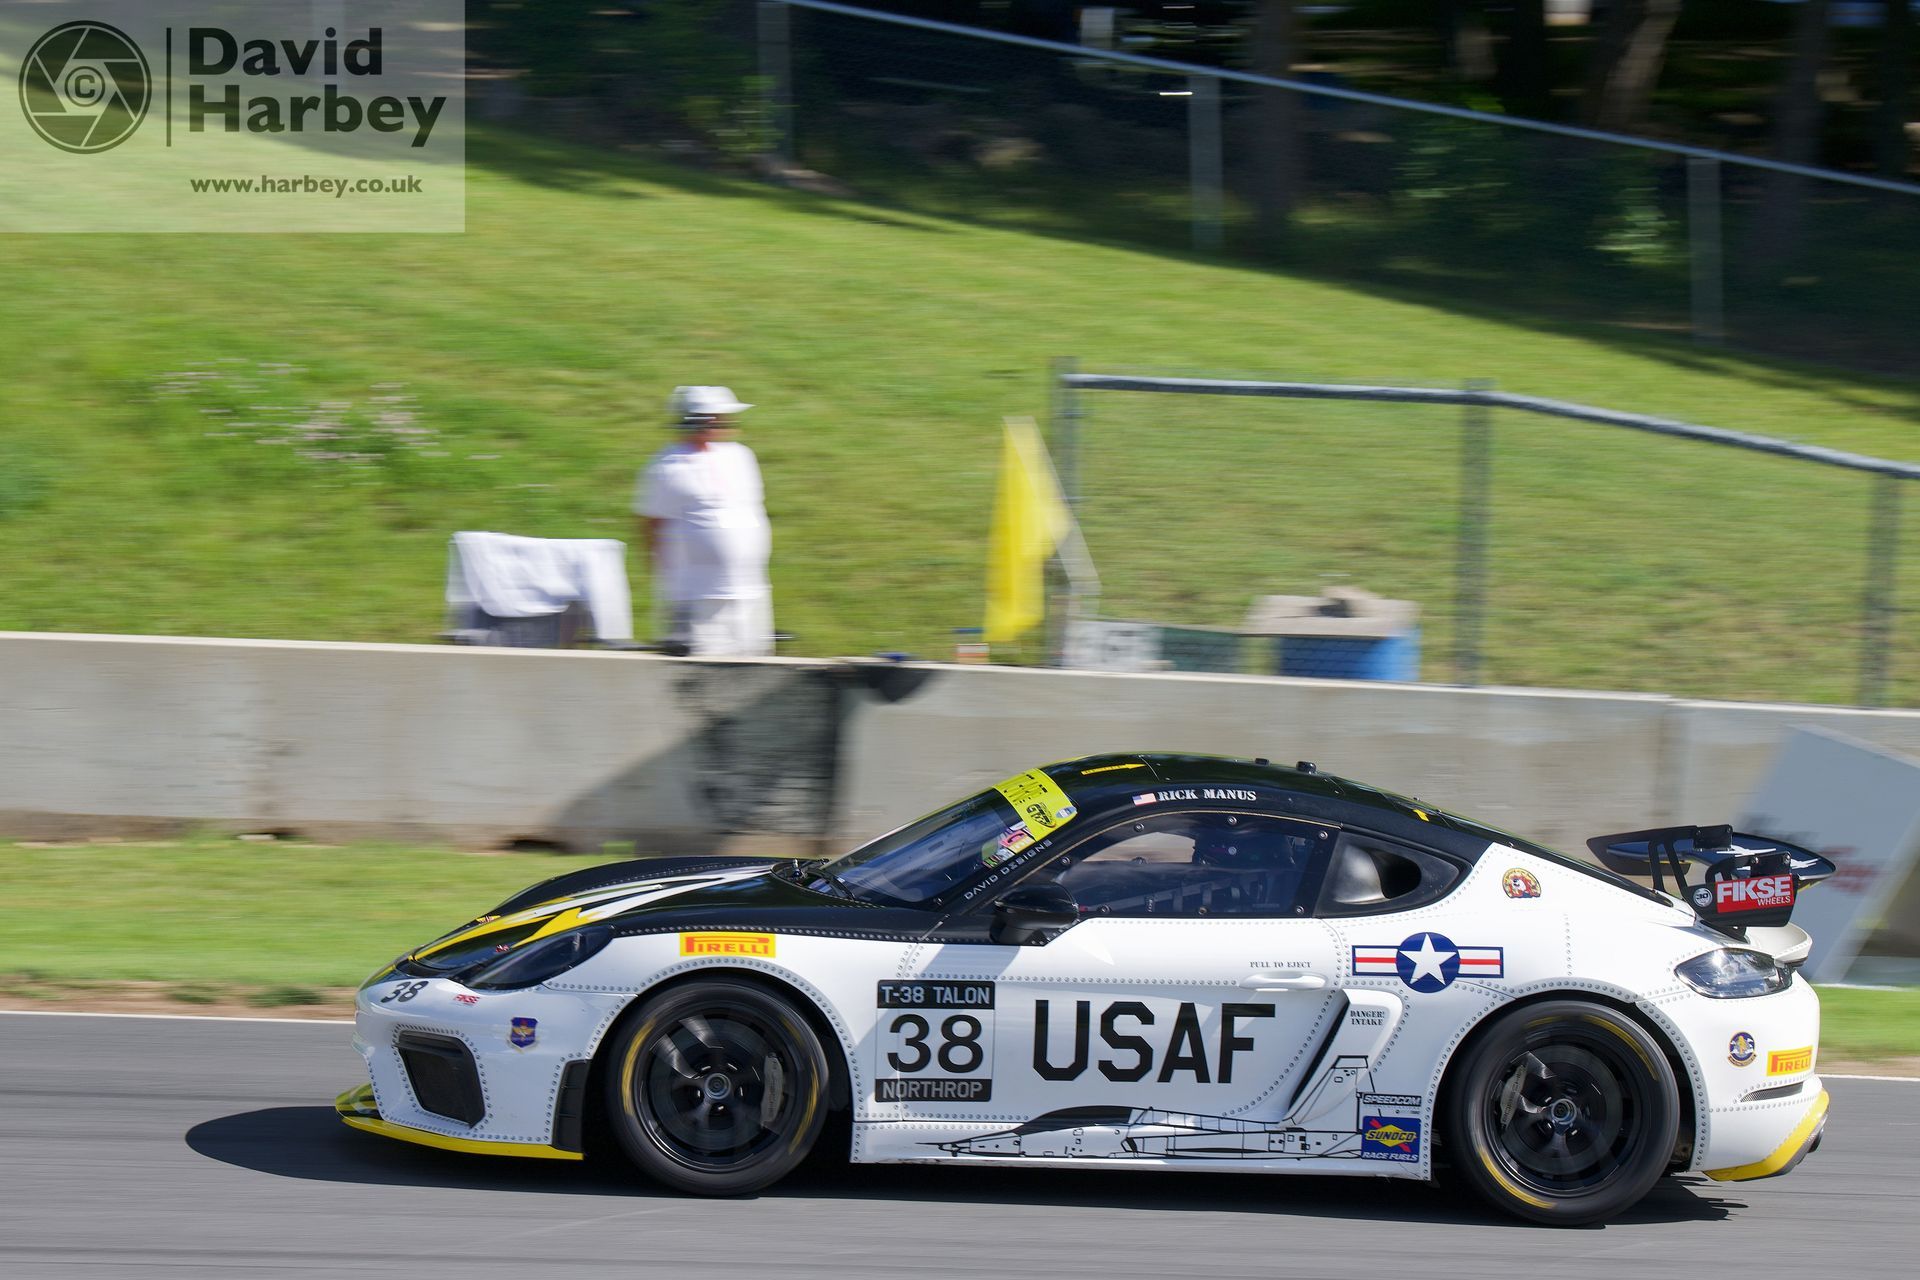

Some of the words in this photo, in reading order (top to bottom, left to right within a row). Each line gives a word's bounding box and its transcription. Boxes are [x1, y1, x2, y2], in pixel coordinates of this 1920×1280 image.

[1157, 789, 1198, 802] RICK
[1203, 789, 1257, 801] MANUS
[964, 874, 999, 900] DAVID
[1717, 876, 1791, 903] FIKSE
[1757, 896, 1791, 906] WHEELS
[685, 936, 770, 954] PIRELLI
[380, 980, 429, 1003] 38
[881, 986, 925, 1004] T-38
[932, 986, 990, 1004] TALON
[1350, 1010, 1385, 1018] DANGER!
[1351, 1018, 1384, 1026] INTAKE
[887, 1013, 984, 1074] 38
[1033, 999, 1276, 1084] USAF
[882, 1081, 983, 1099] NORTHROP
[1363, 1094, 1421, 1106] SPEEDCOM
[1368, 1130, 1415, 1141] SUNOCO
[1362, 1151, 1389, 1160] RACE
[1389, 1153, 1419, 1161] FUELS
